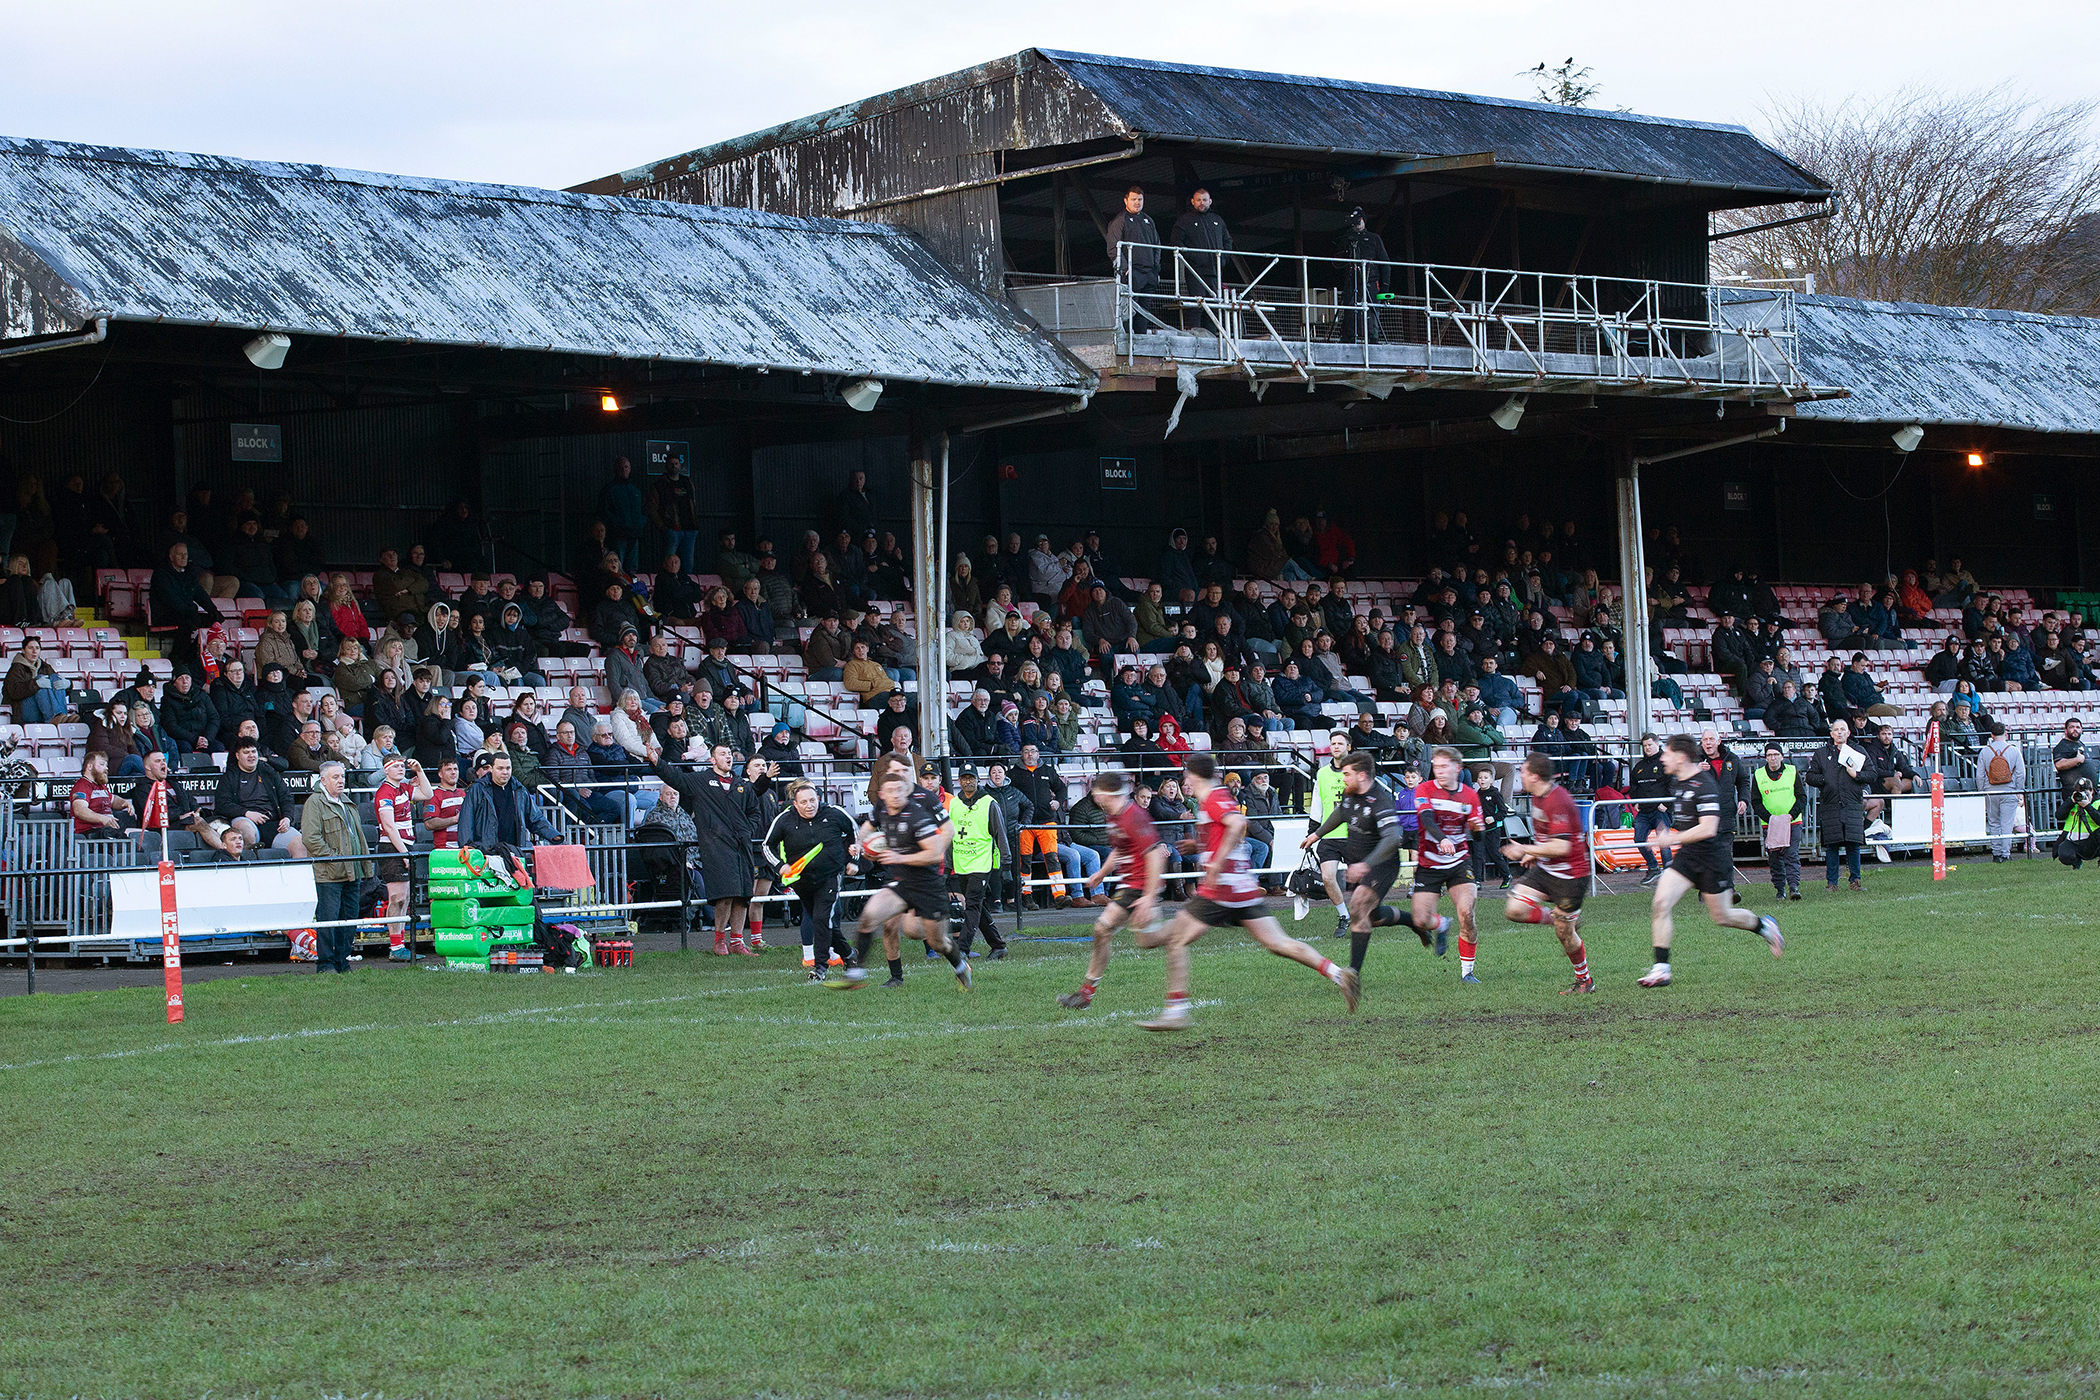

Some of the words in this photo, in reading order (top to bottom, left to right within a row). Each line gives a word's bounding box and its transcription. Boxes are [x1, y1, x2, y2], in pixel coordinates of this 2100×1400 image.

[237, 437, 269, 449] BLOCK
[270, 439, 276, 449] 4
[651, 452, 668, 464] BLO
[679, 454, 685, 464] 5
[1104, 468, 1128, 479] BLOCK
[1127, 469, 1133, 479] 6
[1727, 492, 1744, 500] BLOCK
[2036, 503, 2051, 511] BLOCK
[200, 780, 206, 790] &
[290, 777, 308, 788] ONLY
[158, 791, 169, 827] RHINO
[163, 912, 180, 968] RHINO
